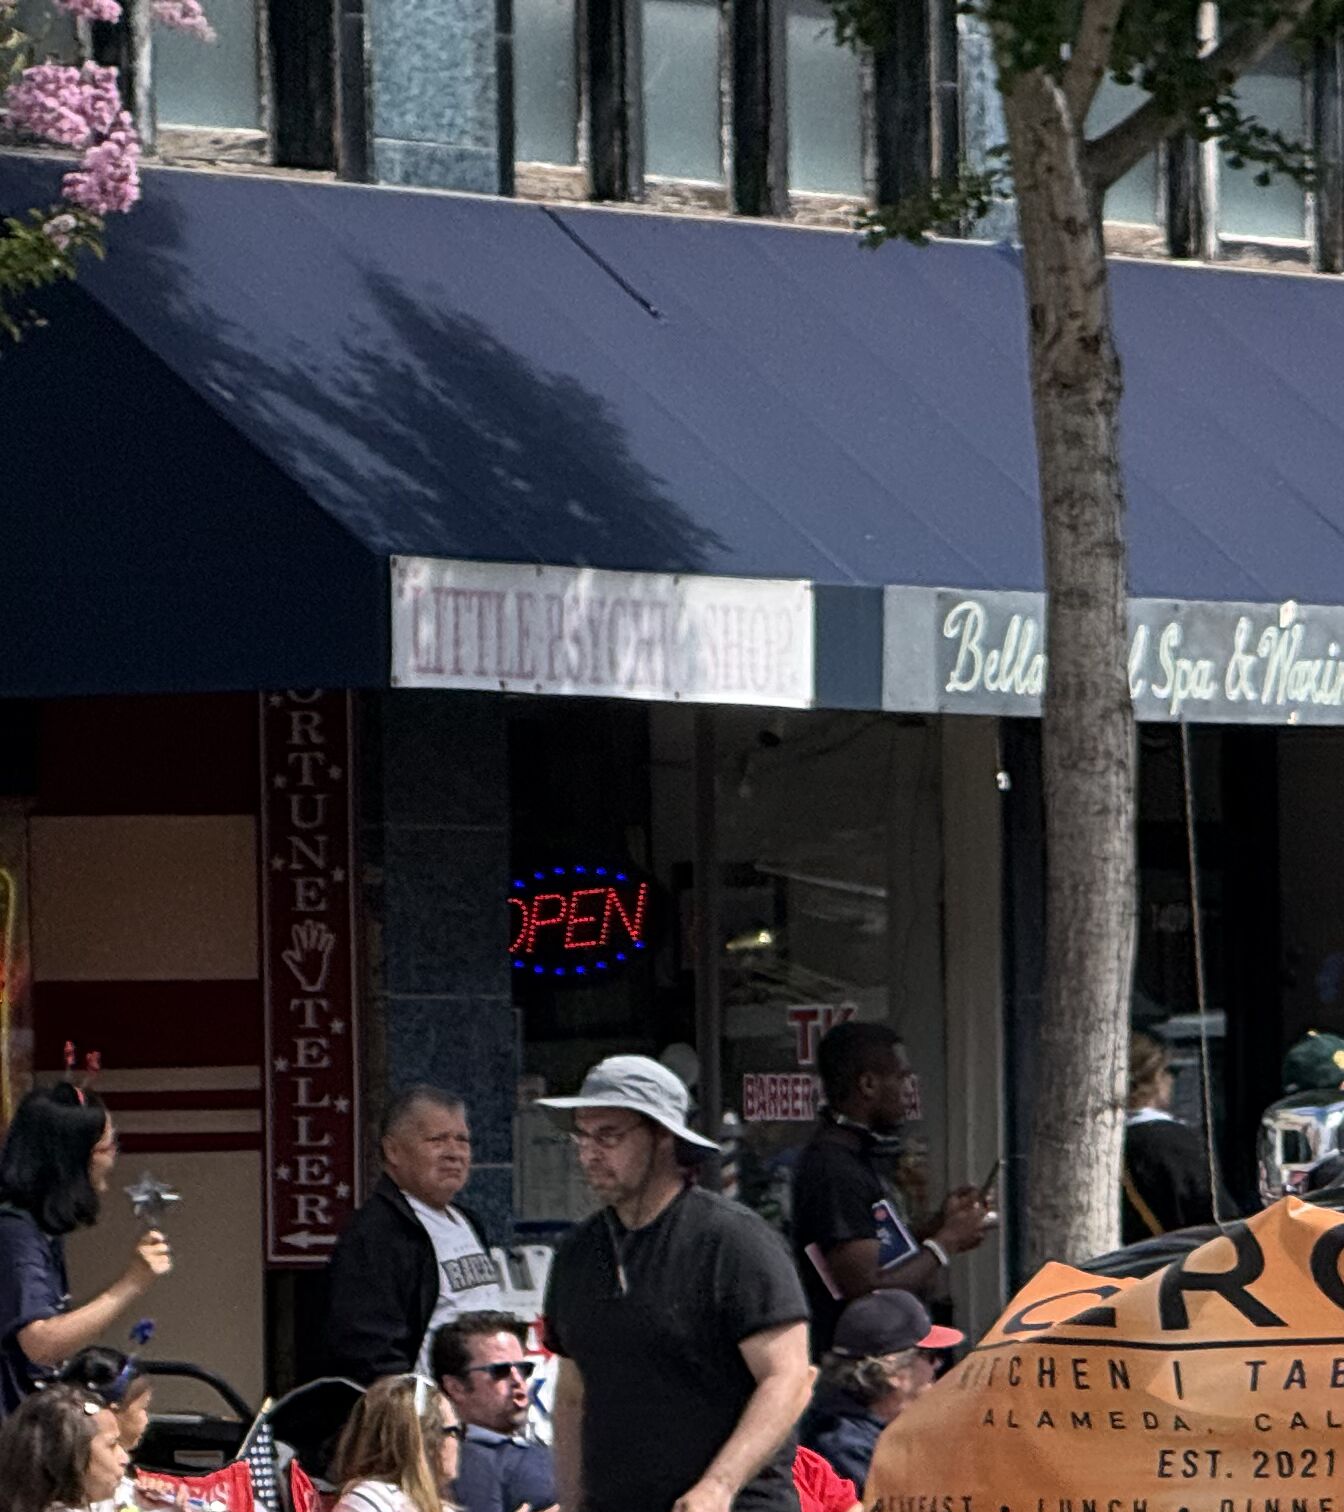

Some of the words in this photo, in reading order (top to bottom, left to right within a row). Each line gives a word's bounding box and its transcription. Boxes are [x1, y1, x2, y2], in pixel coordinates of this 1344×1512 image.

[1152, 621, 1218, 716] Spa
[1224, 616, 1259, 701] &
[289, 998, 334, 1226] TELLER
[743, 1072, 815, 1121] BARBER
[1156, 1448, 1234, 1480] EST.
[1251, 1448, 1337, 1480] 2021
